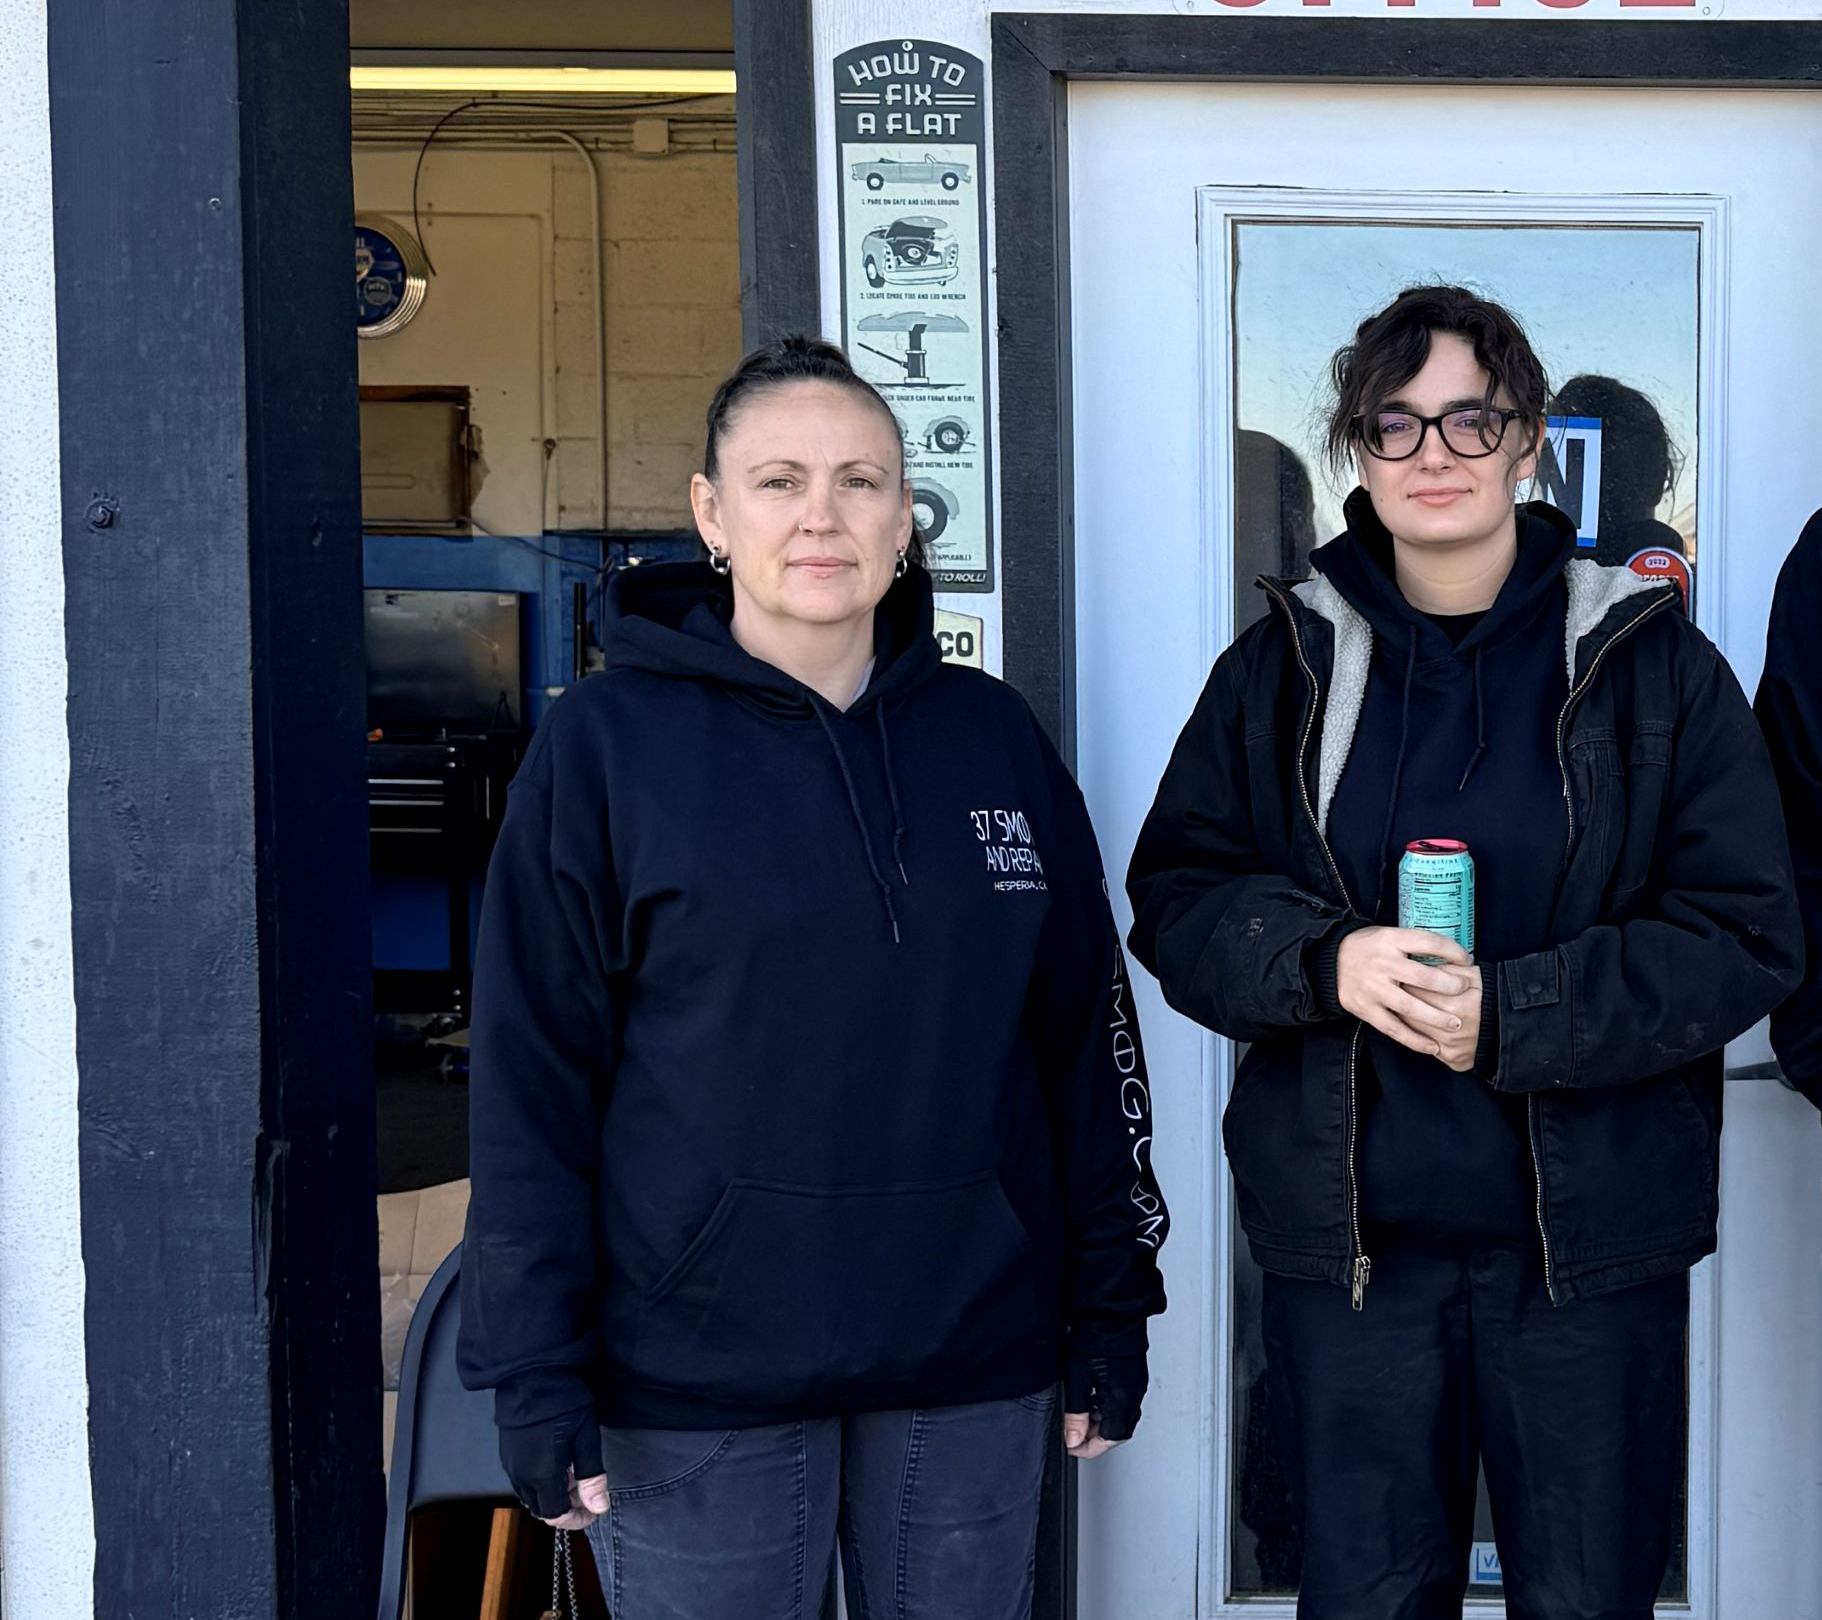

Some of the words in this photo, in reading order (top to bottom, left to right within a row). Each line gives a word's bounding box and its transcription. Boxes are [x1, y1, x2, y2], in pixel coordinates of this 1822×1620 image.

[848, 52, 920, 86] HOW
[929, 55, 966, 86] TO
[885, 83, 932, 106] FIX
[857, 112, 876, 135] A
[885, 112, 962, 136] FLAT
[969, 810, 990, 841] 37
[993, 809, 1035, 846] SMO
[985, 845, 1010, 872] AND
